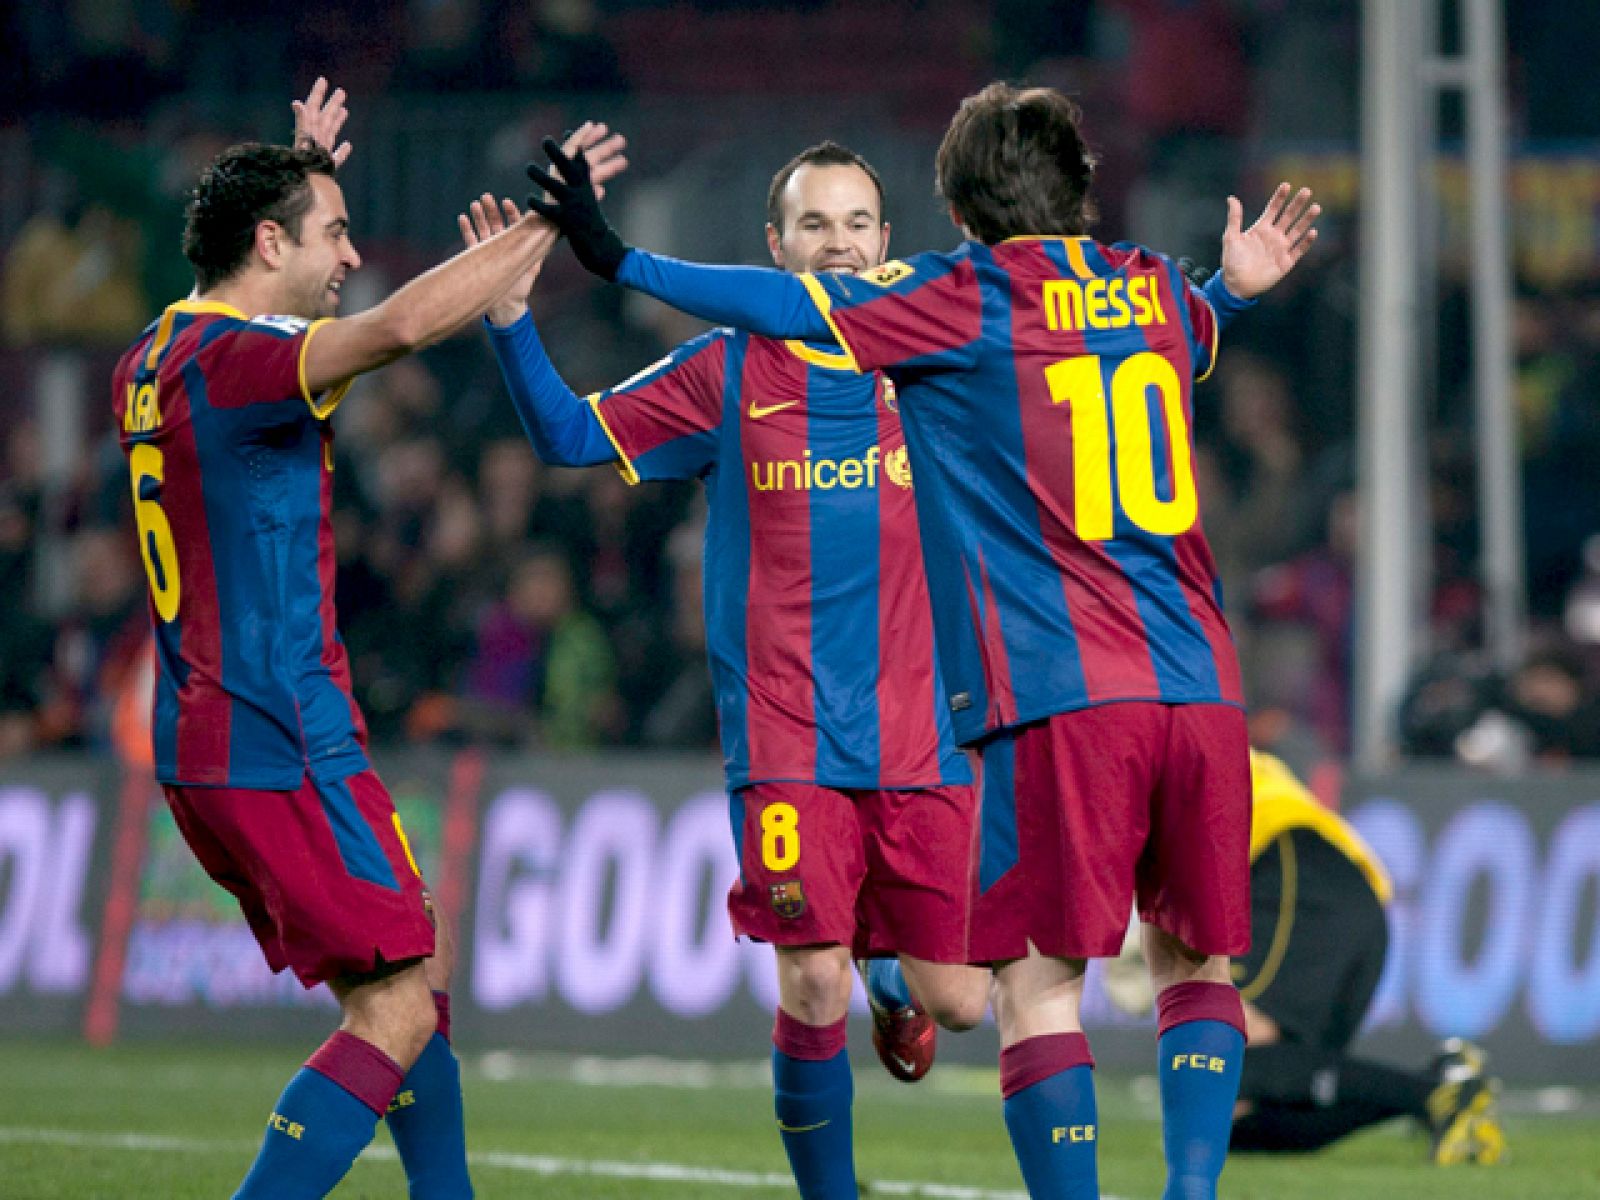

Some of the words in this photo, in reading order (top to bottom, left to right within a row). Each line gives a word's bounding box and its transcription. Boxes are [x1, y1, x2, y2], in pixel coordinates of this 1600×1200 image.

[1043, 275, 1168, 330] MESSI
[751, 444, 880, 491] unicef
[1044, 351, 1197, 540] 10
[130, 443, 181, 623] 6
[761, 802, 800, 872] 8
[1171, 1053, 1226, 1073] FCB
